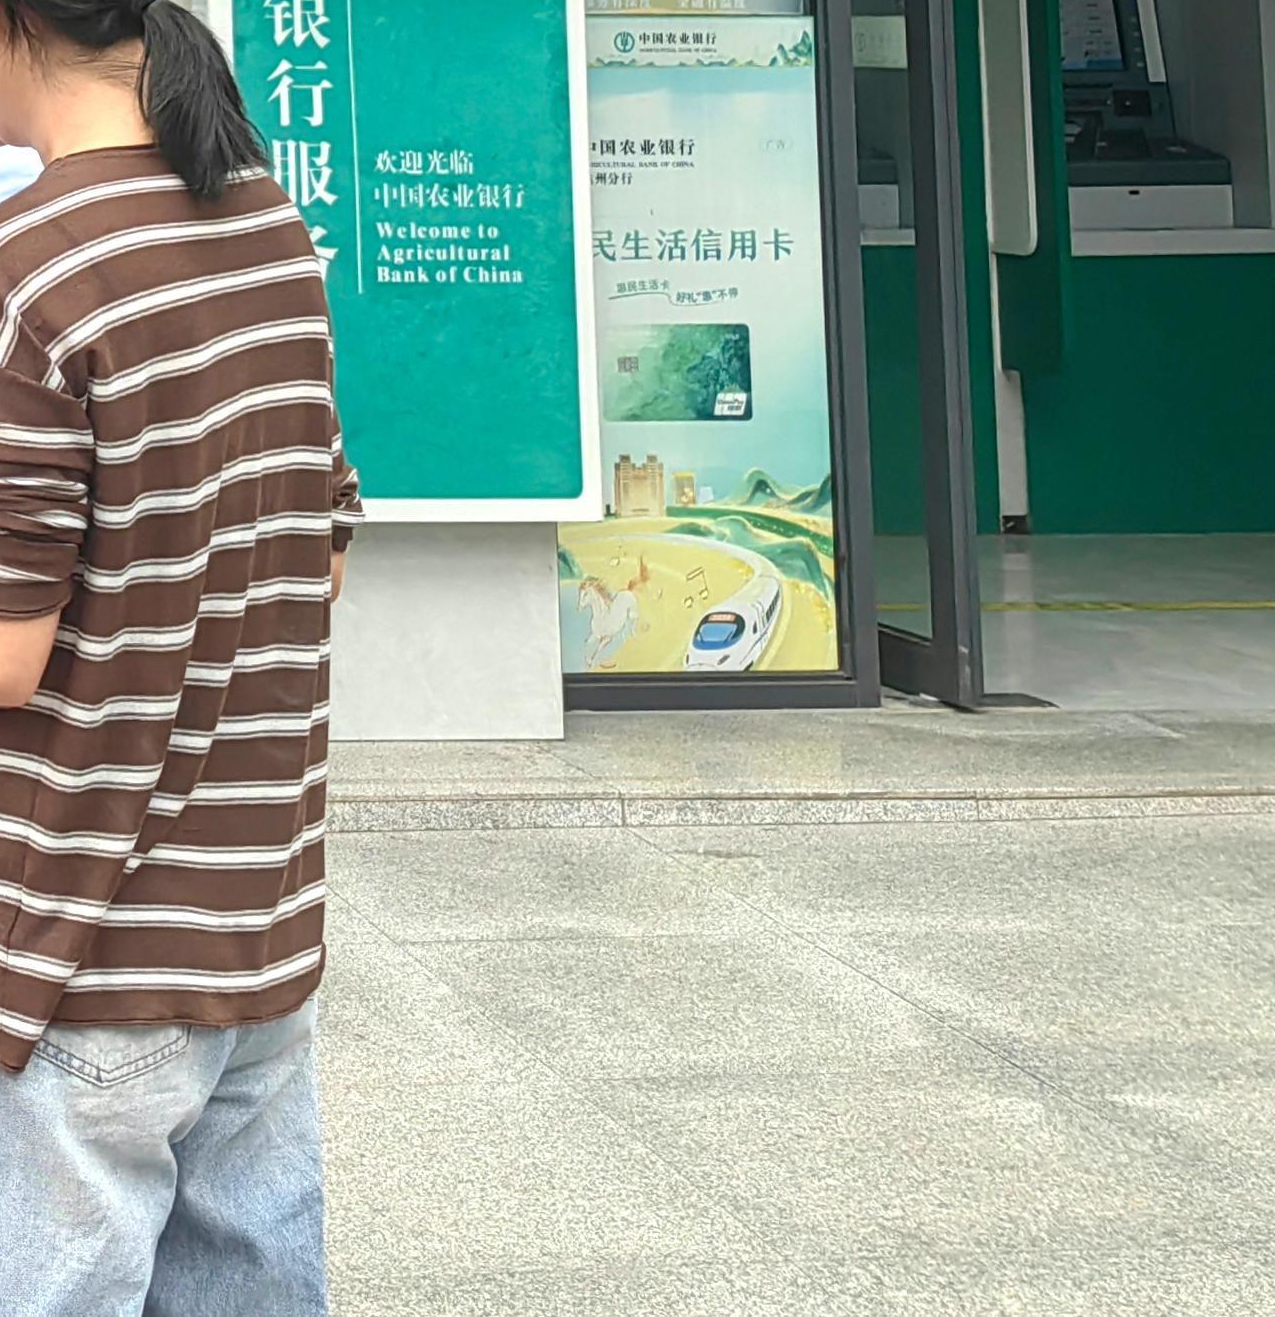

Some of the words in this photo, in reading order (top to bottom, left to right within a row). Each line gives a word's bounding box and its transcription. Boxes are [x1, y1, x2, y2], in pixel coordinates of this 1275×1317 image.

[638, 31, 718, 45] 中国农业银行
[373, 148, 474, 175] 欢迎光临
[590, 171, 633, 186] 州分行
[373, 184, 525, 210] 中国农业银行
[376, 221, 472, 240] Welcome
[477, 221, 499, 240] to
[377, 243, 511, 265] Agricultural
[377, 265, 430, 283] Bank
[435, 265, 457, 283] of
[461, 265, 524, 283] China
